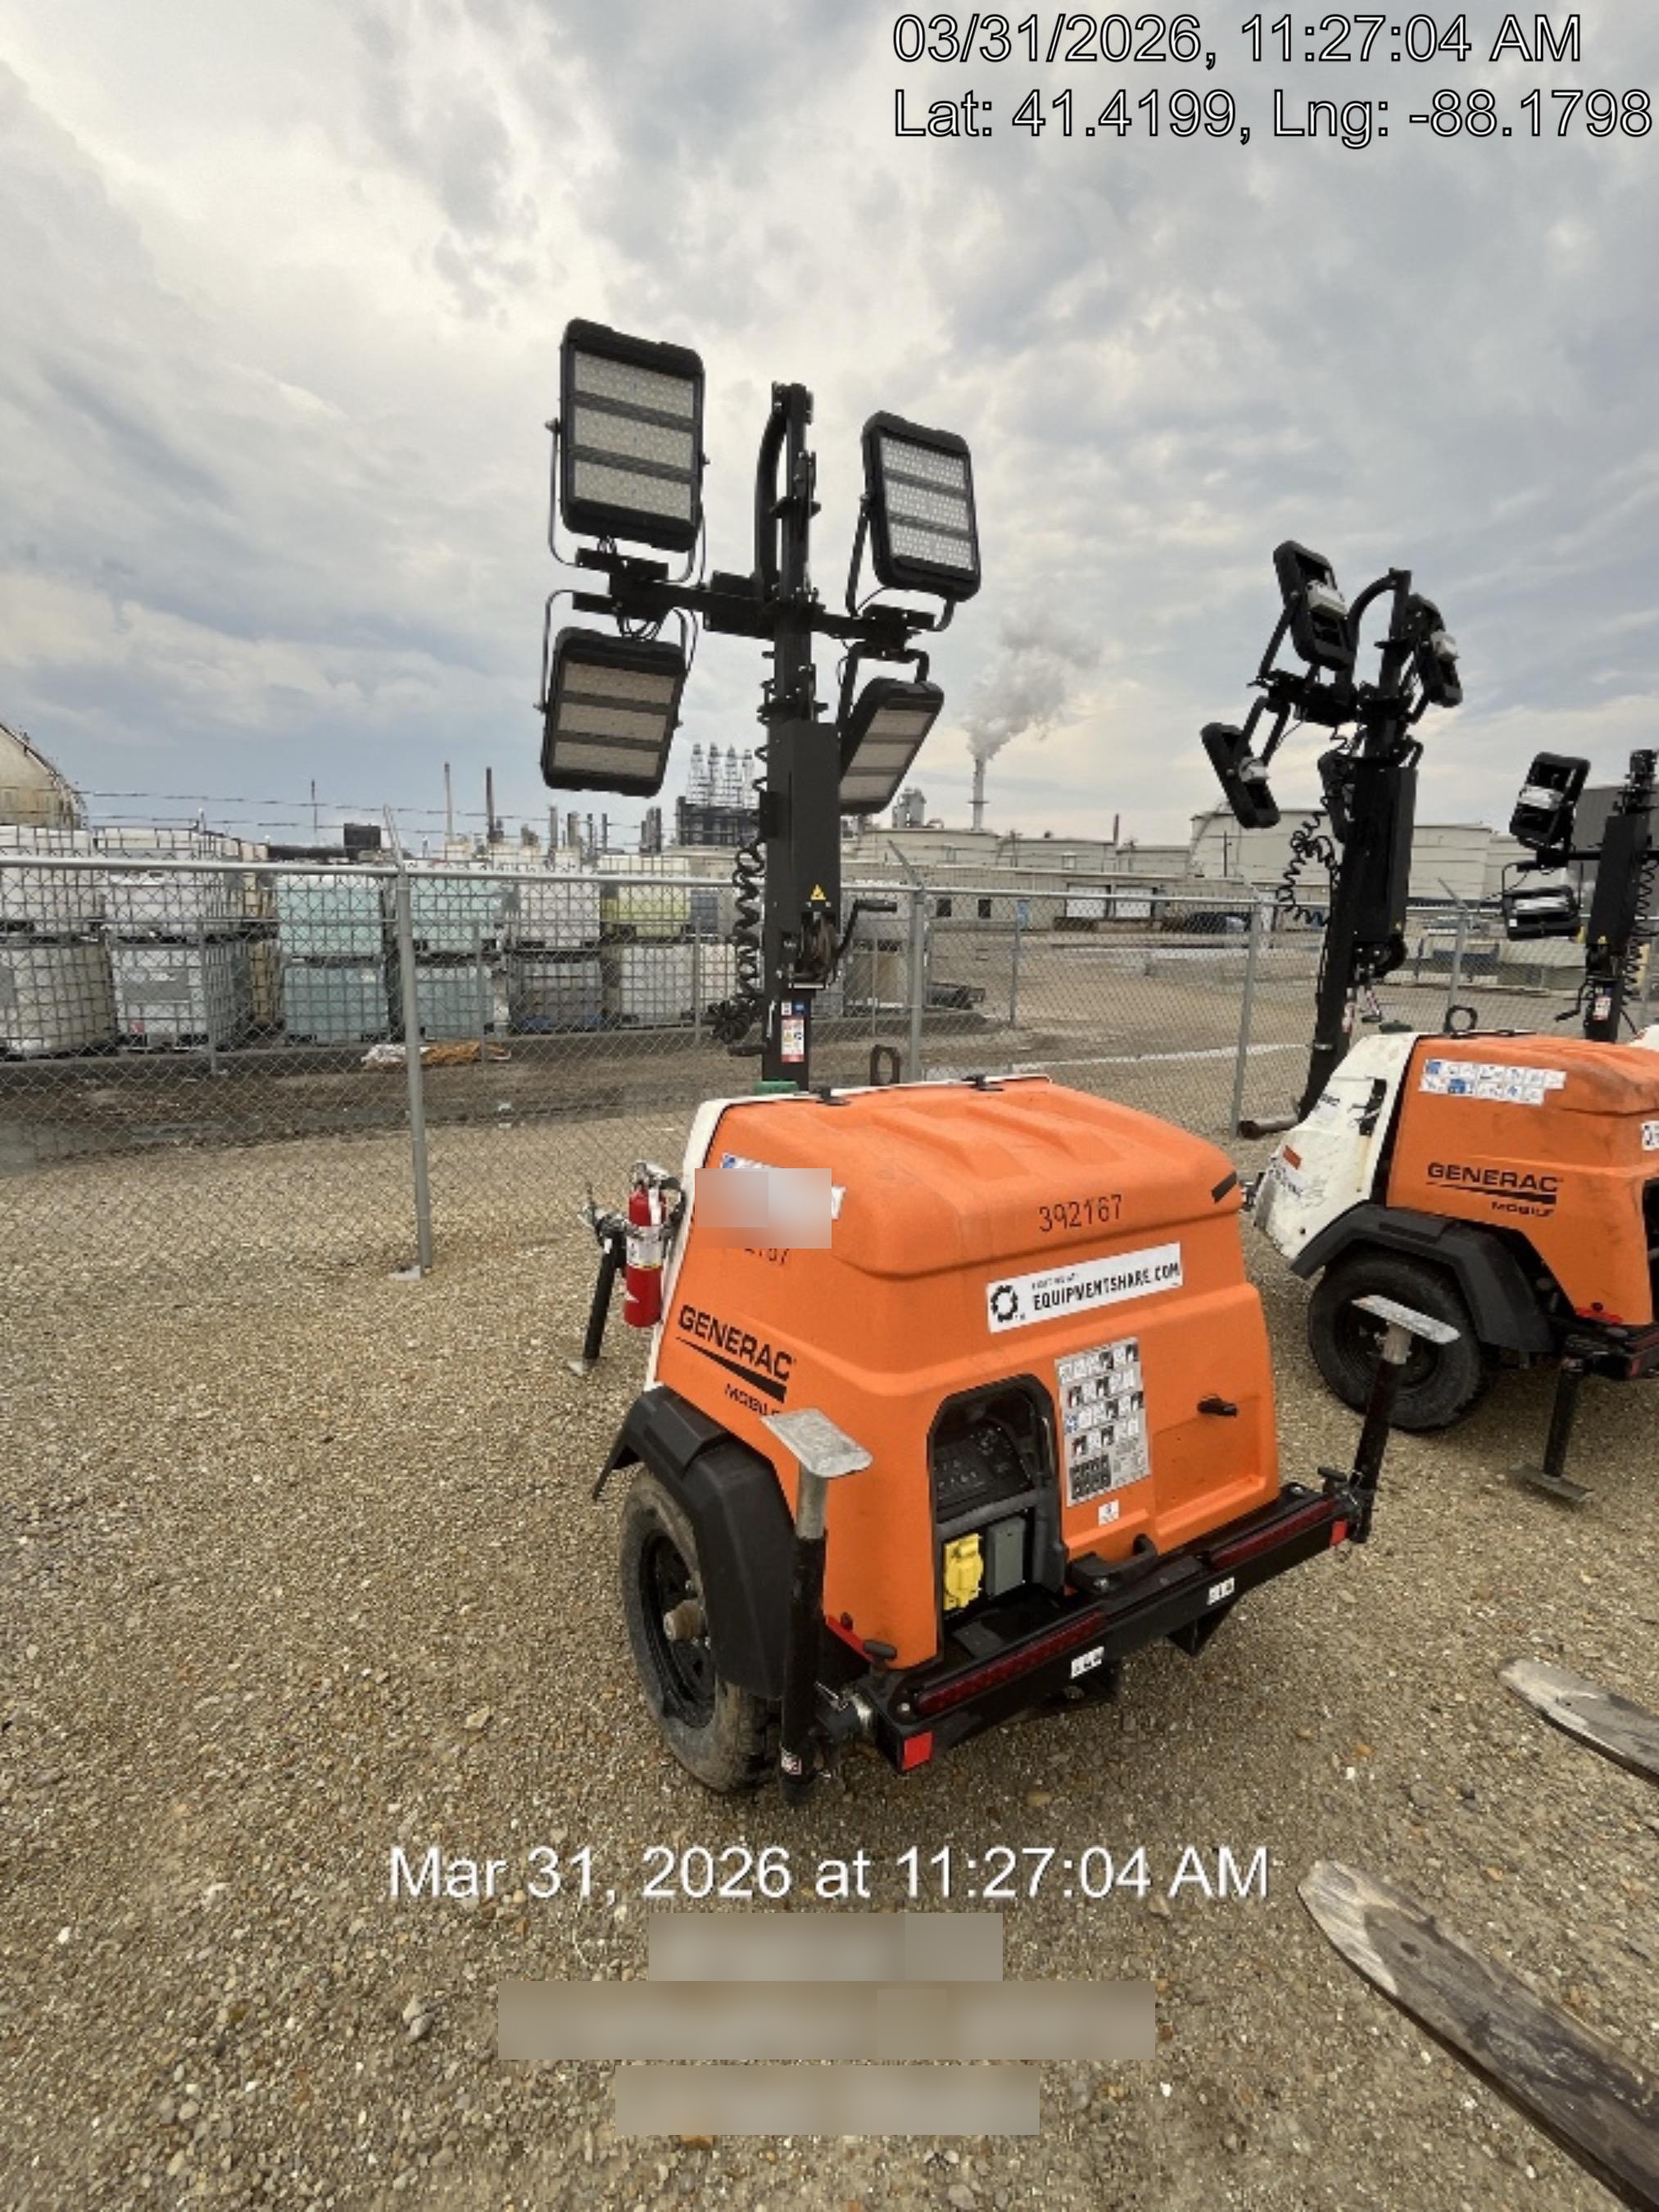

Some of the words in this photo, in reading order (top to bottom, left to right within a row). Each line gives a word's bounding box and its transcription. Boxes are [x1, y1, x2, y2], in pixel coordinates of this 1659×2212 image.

[1428, 1162, 1558, 1192] GENERAC
[1038, 1194, 1122, 1232] 392167
[678, 1304, 793, 1382] GENERAC
